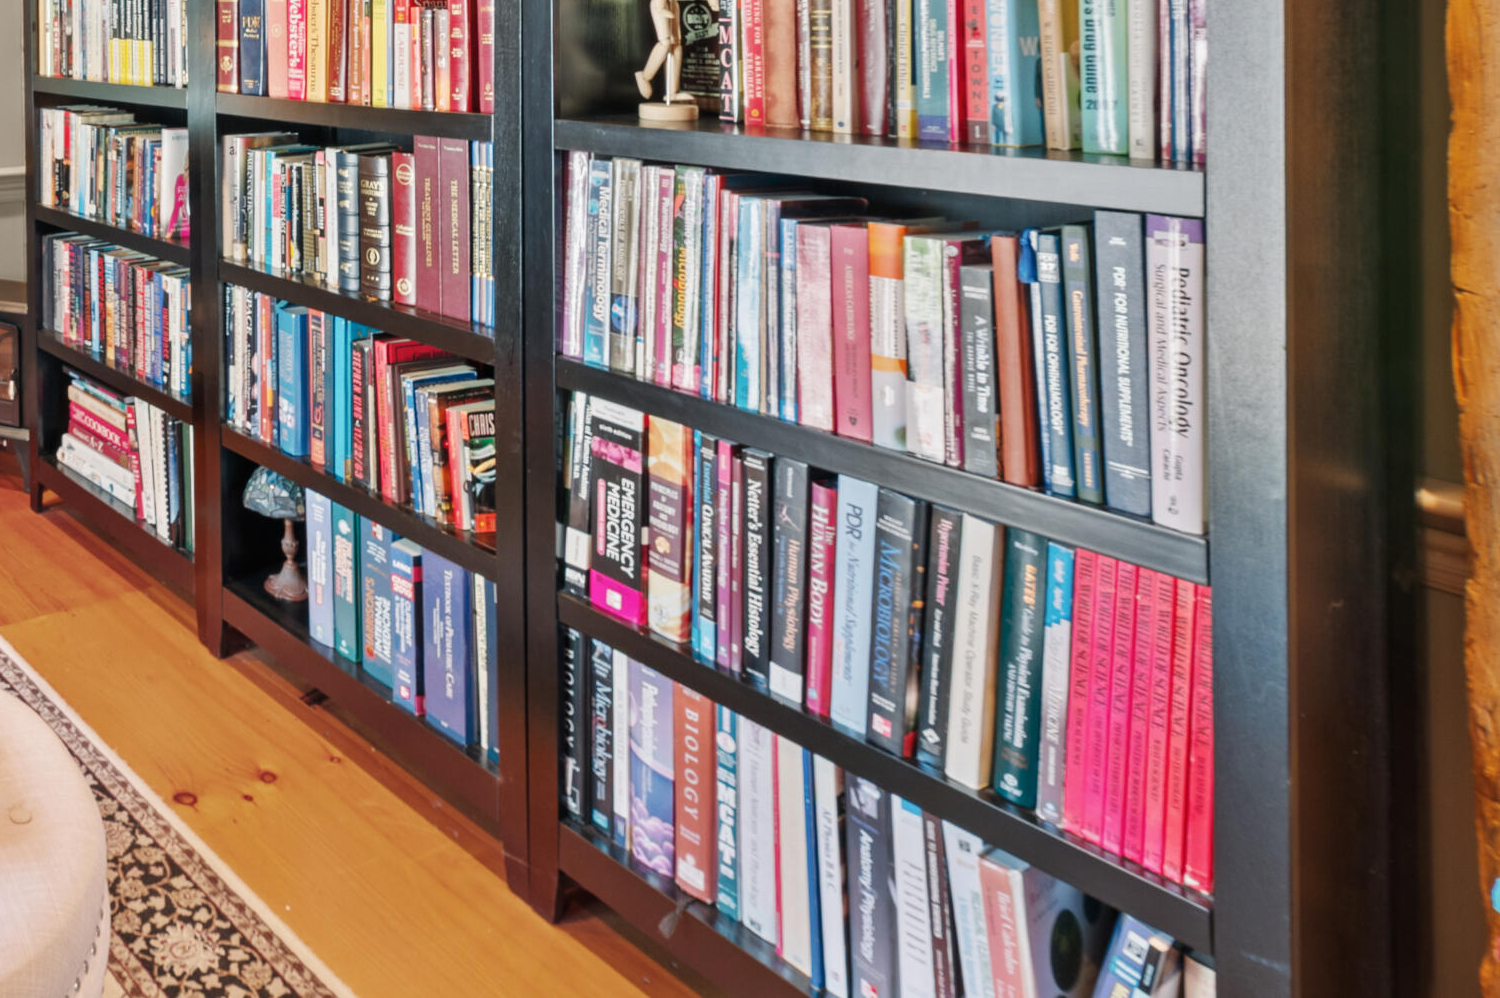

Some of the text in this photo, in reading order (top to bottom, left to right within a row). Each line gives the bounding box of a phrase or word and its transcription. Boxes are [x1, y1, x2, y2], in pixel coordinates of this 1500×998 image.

[310, 35, 319, 92] Thesaurus
[754, 27, 762, 45] FOR
[899, 23, 907, 91] Clinical Ethics
[719, 25, 733, 113] MCAT
[747, 52, 755, 99] VERGHESE
[754, 55, 762, 98] ABRAHAM
[970, 50, 982, 114] TOWNS
[451, 200, 459, 238] MEDICAL
[597, 186, 610, 238] Medical
[659, 197, 670, 253] Pharmacology
[590, 240, 610, 322] Terminology
[975, 315, 990, 413] A Wrinkle in Time
[1046, 334, 1058, 352] FOR
[1072, 290, 1091, 427] Gastrointestinal Pharmacotherapy
[1114, 293, 1130, 375] FOR NUTRITIONAL
[1153, 263, 1168, 432] Surgical and Medical Aspects
[1168, 267, 1192, 438] Pediatric Oncology
[352, 350, 364, 479] STEPHEN KING 11/22/63
[578, 436, 591, 500] Human Anatomy
[1173, 455, 1184, 480] Gupta
[606, 481, 620, 562] MEDICINE
[620, 478, 635, 579] EMERGENCY
[701, 461, 713, 603] Essential CLINICAL ANATOMY
[719, 488, 729, 589] Principles Pharmacology
[825, 525, 836, 546] The
[744, 478, 763, 658] Netter's Essential Histology
[809, 503, 829, 630] HUMAN BODY
[842, 502, 863, 682] PDR Nutritional Supplements
[935, 519, 952, 606] Hypertension Primer
[1023, 564, 1036, 610] BATES'
[1100, 561, 1112, 586] THE
[1119, 568, 1133, 592] THE
[1139, 574, 1152, 598] THE
[374, 595, 382, 652] INTERNAL
[782, 539, 801, 654] Human Physiology
[874, 540, 902, 690] MICROBIOLOGY
[1022, 609, 1033, 634] Guide
[1074, 555, 1092, 699] THE WORLD OF SCIENCE
[1098, 589, 1111, 630] WORLD
[1118, 595, 1132, 636] WORLD
[1137, 603, 1150, 642] WORLD
[382, 597, 391, 659] MEDICINE
[444, 569, 454, 700] TEXTBOOK PEDIATRIC CARE
[960, 555, 982, 744] Basic X-Ray Machine Operator Study Guide
[1020, 635, 1030, 646] to
[1097, 635, 1109, 651] OF
[1116, 642, 1130, 659] OF
[1136, 648, 1148, 665] OF
[1151, 579, 1172, 731] THE WORLD OF SCIENCE
[1017, 646, 1032, 688] Physical
[1094, 655, 1108, 708] SCIENCE
[1113, 661, 1128, 715] SCIENCE
[1171, 586, 1189, 738] THE WORLD OF SCIENCE
[1196, 594, 1212, 748] THE WORLD OF SCIENCE
[1013, 689, 1028, 748] Examination
[1046, 682, 1061, 745] MEDICINE
[1132, 665, 1147, 723] SCIENCE
[593, 681, 612, 782] Microbiology
[684, 707, 699, 821] BIOLOGY
[822, 808, 831, 824] AP
[822, 827, 833, 858] Physics
[826, 882, 836, 892] C
[859, 830, 877, 963] Anatomy Physiology
[996, 891, 1018, 975] Brief Calculus
